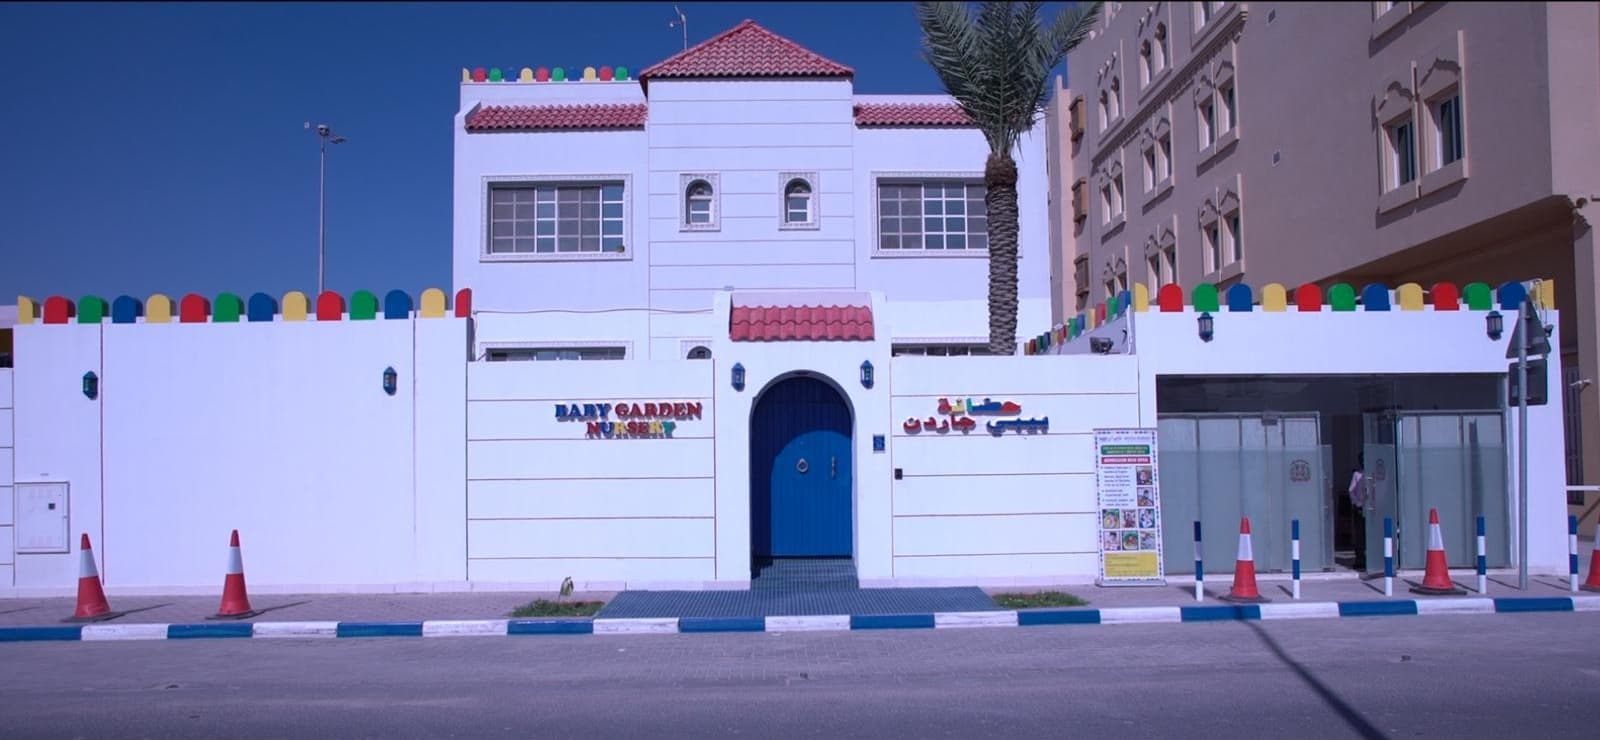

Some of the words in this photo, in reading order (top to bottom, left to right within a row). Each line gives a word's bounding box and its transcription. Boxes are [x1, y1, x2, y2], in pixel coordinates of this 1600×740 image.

[555, 403, 611, 419] BABY
[614, 402, 702, 419] GARDEN
[938, 398, 1021, 415] حضانة
[587, 421, 676, 436] NURSERY
[903, 414, 977, 434] جاردن
[986, 416, 1049, 436] بيبي
